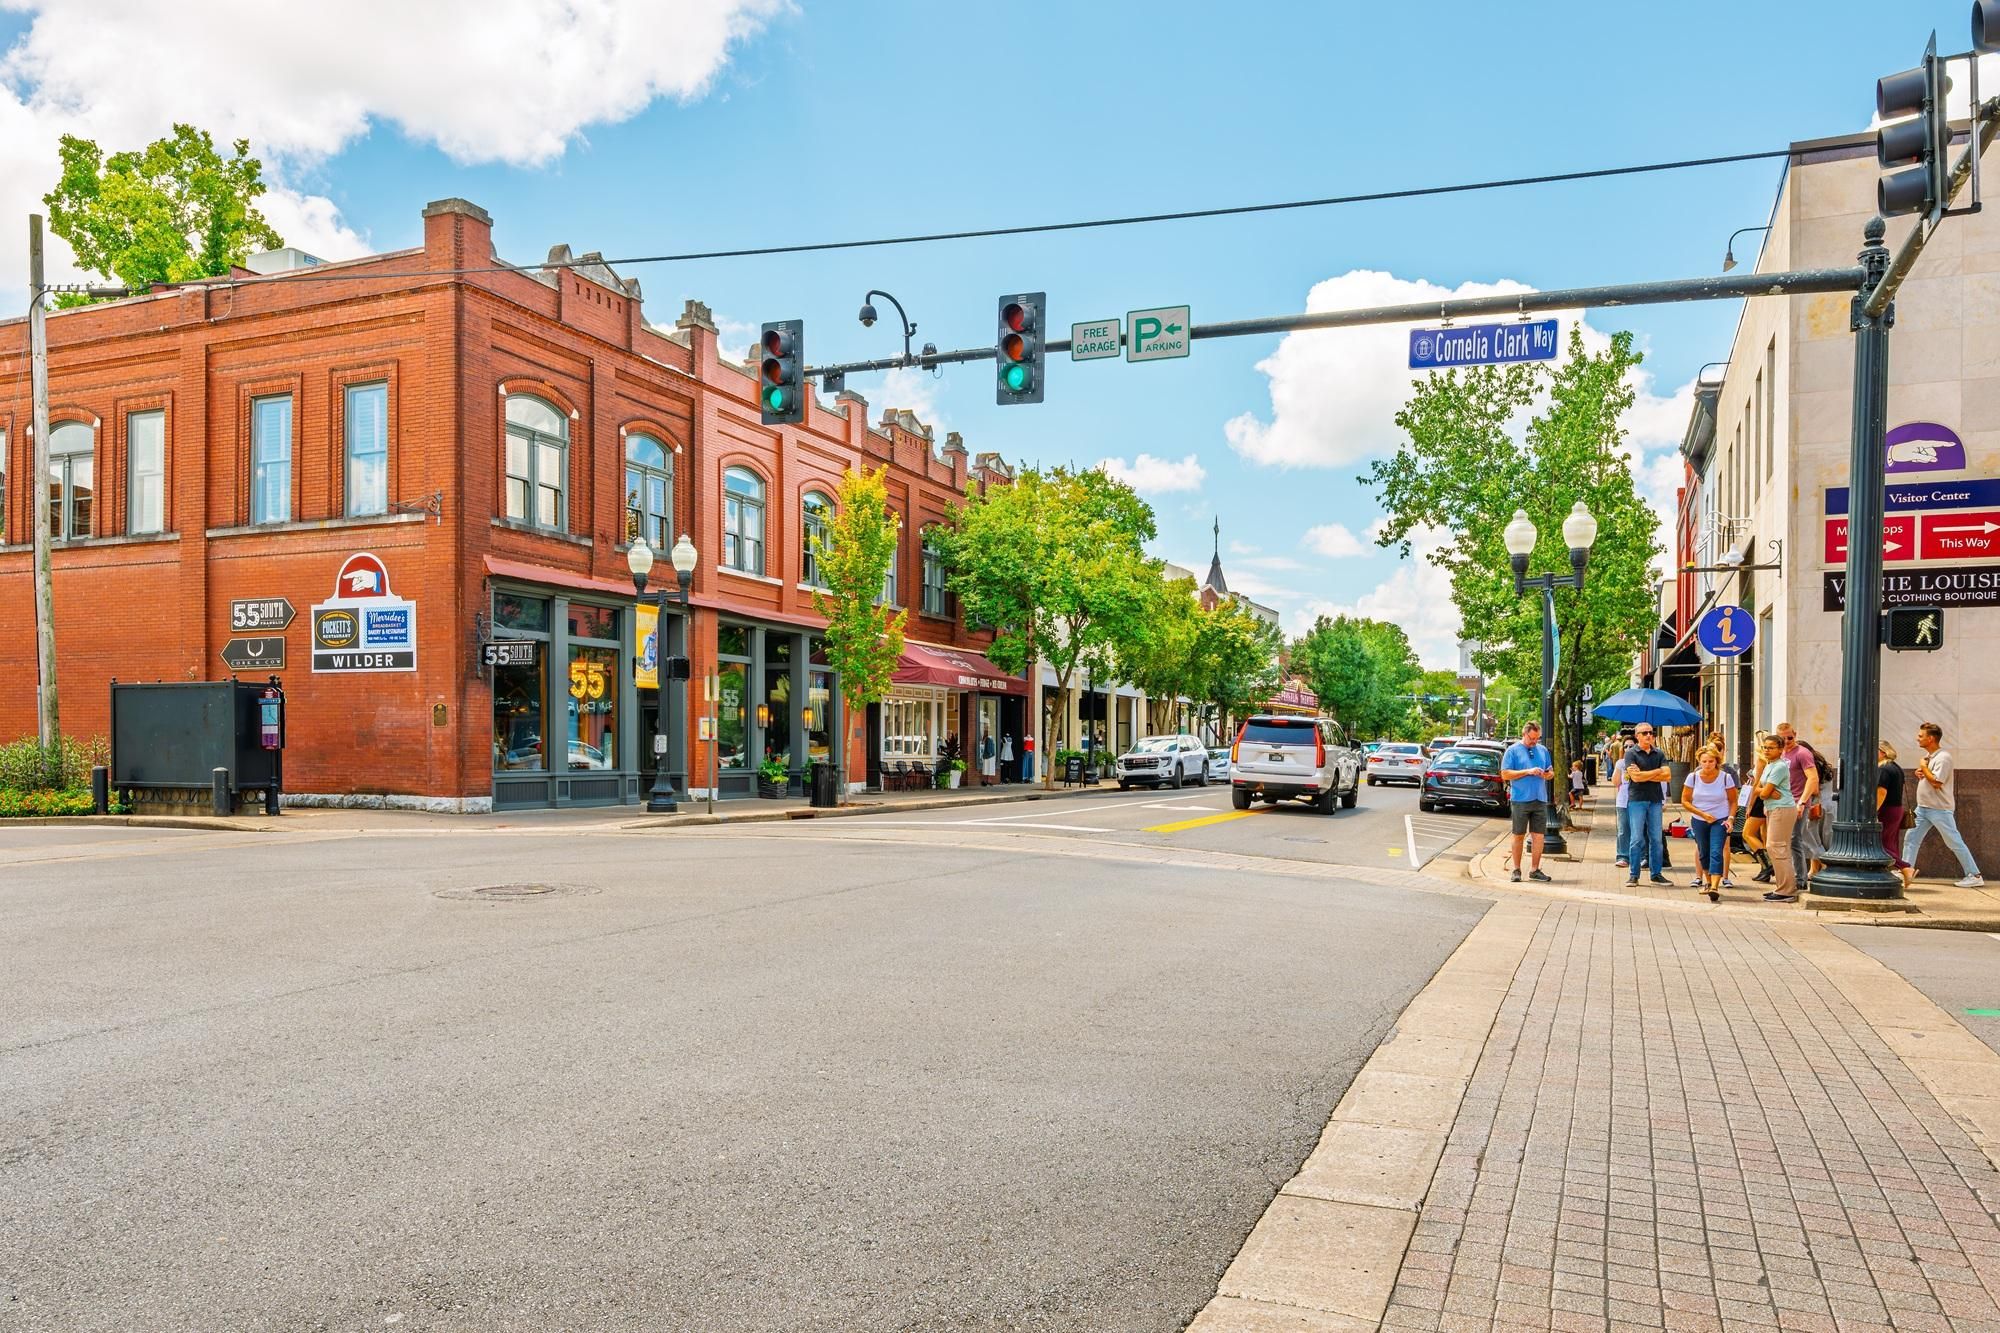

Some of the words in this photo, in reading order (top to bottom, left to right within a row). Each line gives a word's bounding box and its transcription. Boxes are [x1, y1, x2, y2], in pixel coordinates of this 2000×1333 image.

[1083, 327, 1109, 339] FREE
[1076, 340, 1116, 354] GARAGE
[1435, 329, 1488, 362] Cornelia
[1494, 327, 1529, 359] Clark
[1533, 325, 1554, 353] Way
[1888, 493, 1928, 503] Visitor
[1931, 491, 1971, 501] Center
[1940, 538, 1963, 549] This
[1966, 537, 1990, 549] Way
[1888, 592, 1941, 602] CLOTHING
[1944, 591, 1997, 601] BOUTIQUE
[233, 603, 260, 627] 55
[260, 602, 283, 618] SOUTH
[368, 611, 405, 624] Merridee's
[323, 620, 351, 634] PUCKETT'S
[332, 654, 394, 667] WILDER
[484, 645, 510, 664] 55
[510, 645, 533, 659] SOUTH
[569, 662, 605, 698] 55
[723, 689, 739, 706] 55
